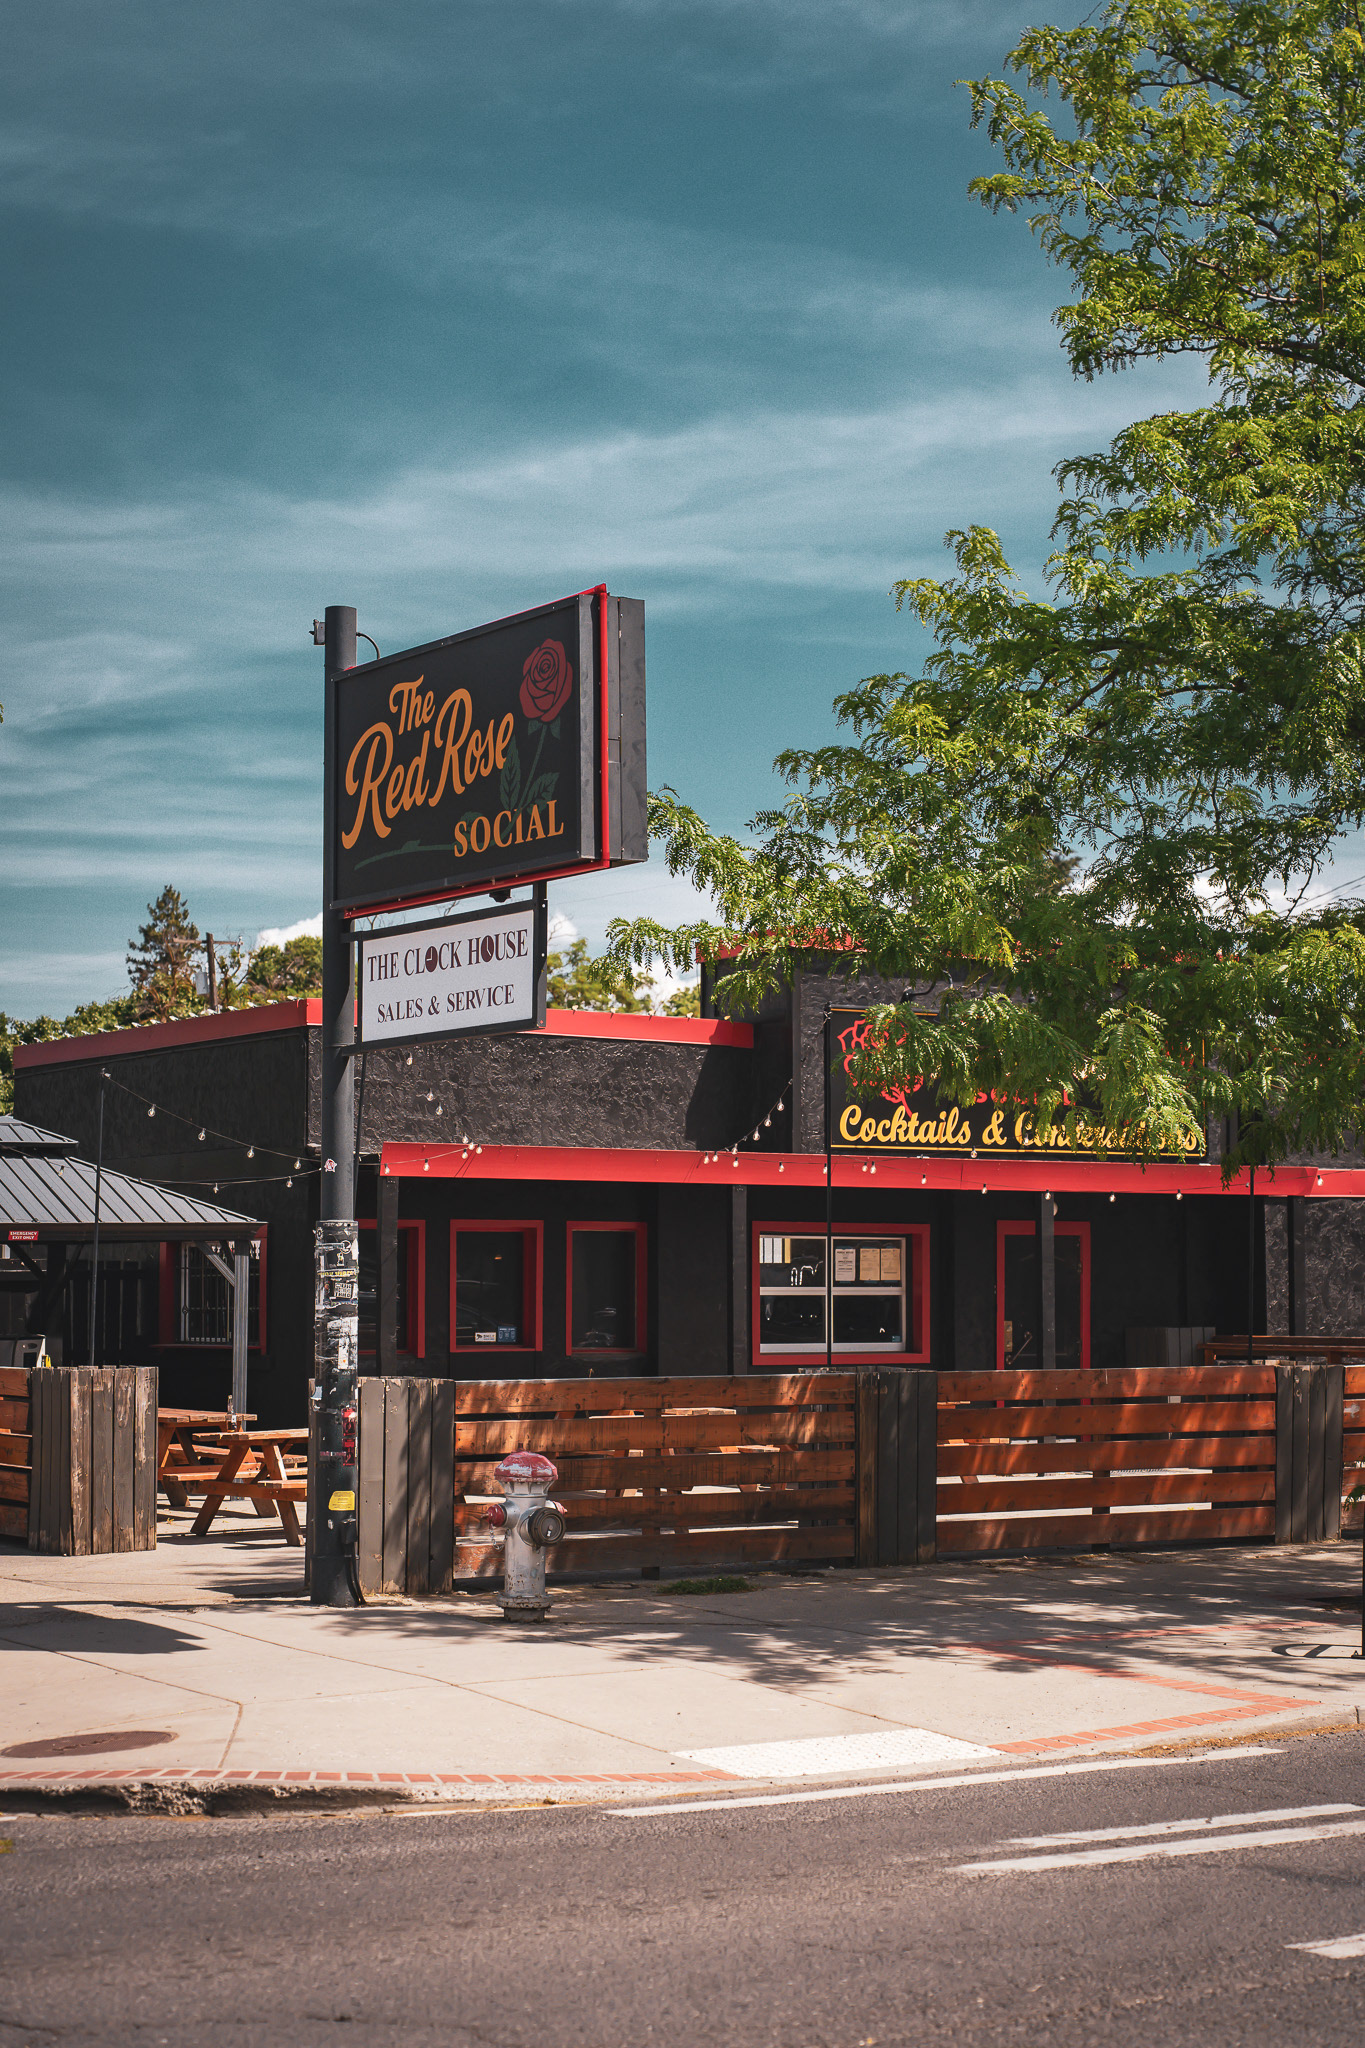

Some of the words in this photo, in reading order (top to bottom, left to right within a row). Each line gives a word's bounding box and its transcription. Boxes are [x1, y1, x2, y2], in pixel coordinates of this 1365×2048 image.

[389, 674, 436, 736] The
[341, 721, 431, 850] Red
[428, 688, 515, 808] Rose
[454, 800, 565, 858] SOCIAL
[367, 952, 399, 982] THE
[404, 940, 462, 976] CLOCK
[467, 928, 529, 965] HOUSE
[377, 998, 423, 1024] SALES
[427, 995, 441, 1016] &
[446, 984, 515, 1013] SERVICE
[839, 1104, 972, 1144] Cocktails
[981, 1110, 1008, 1145] &
